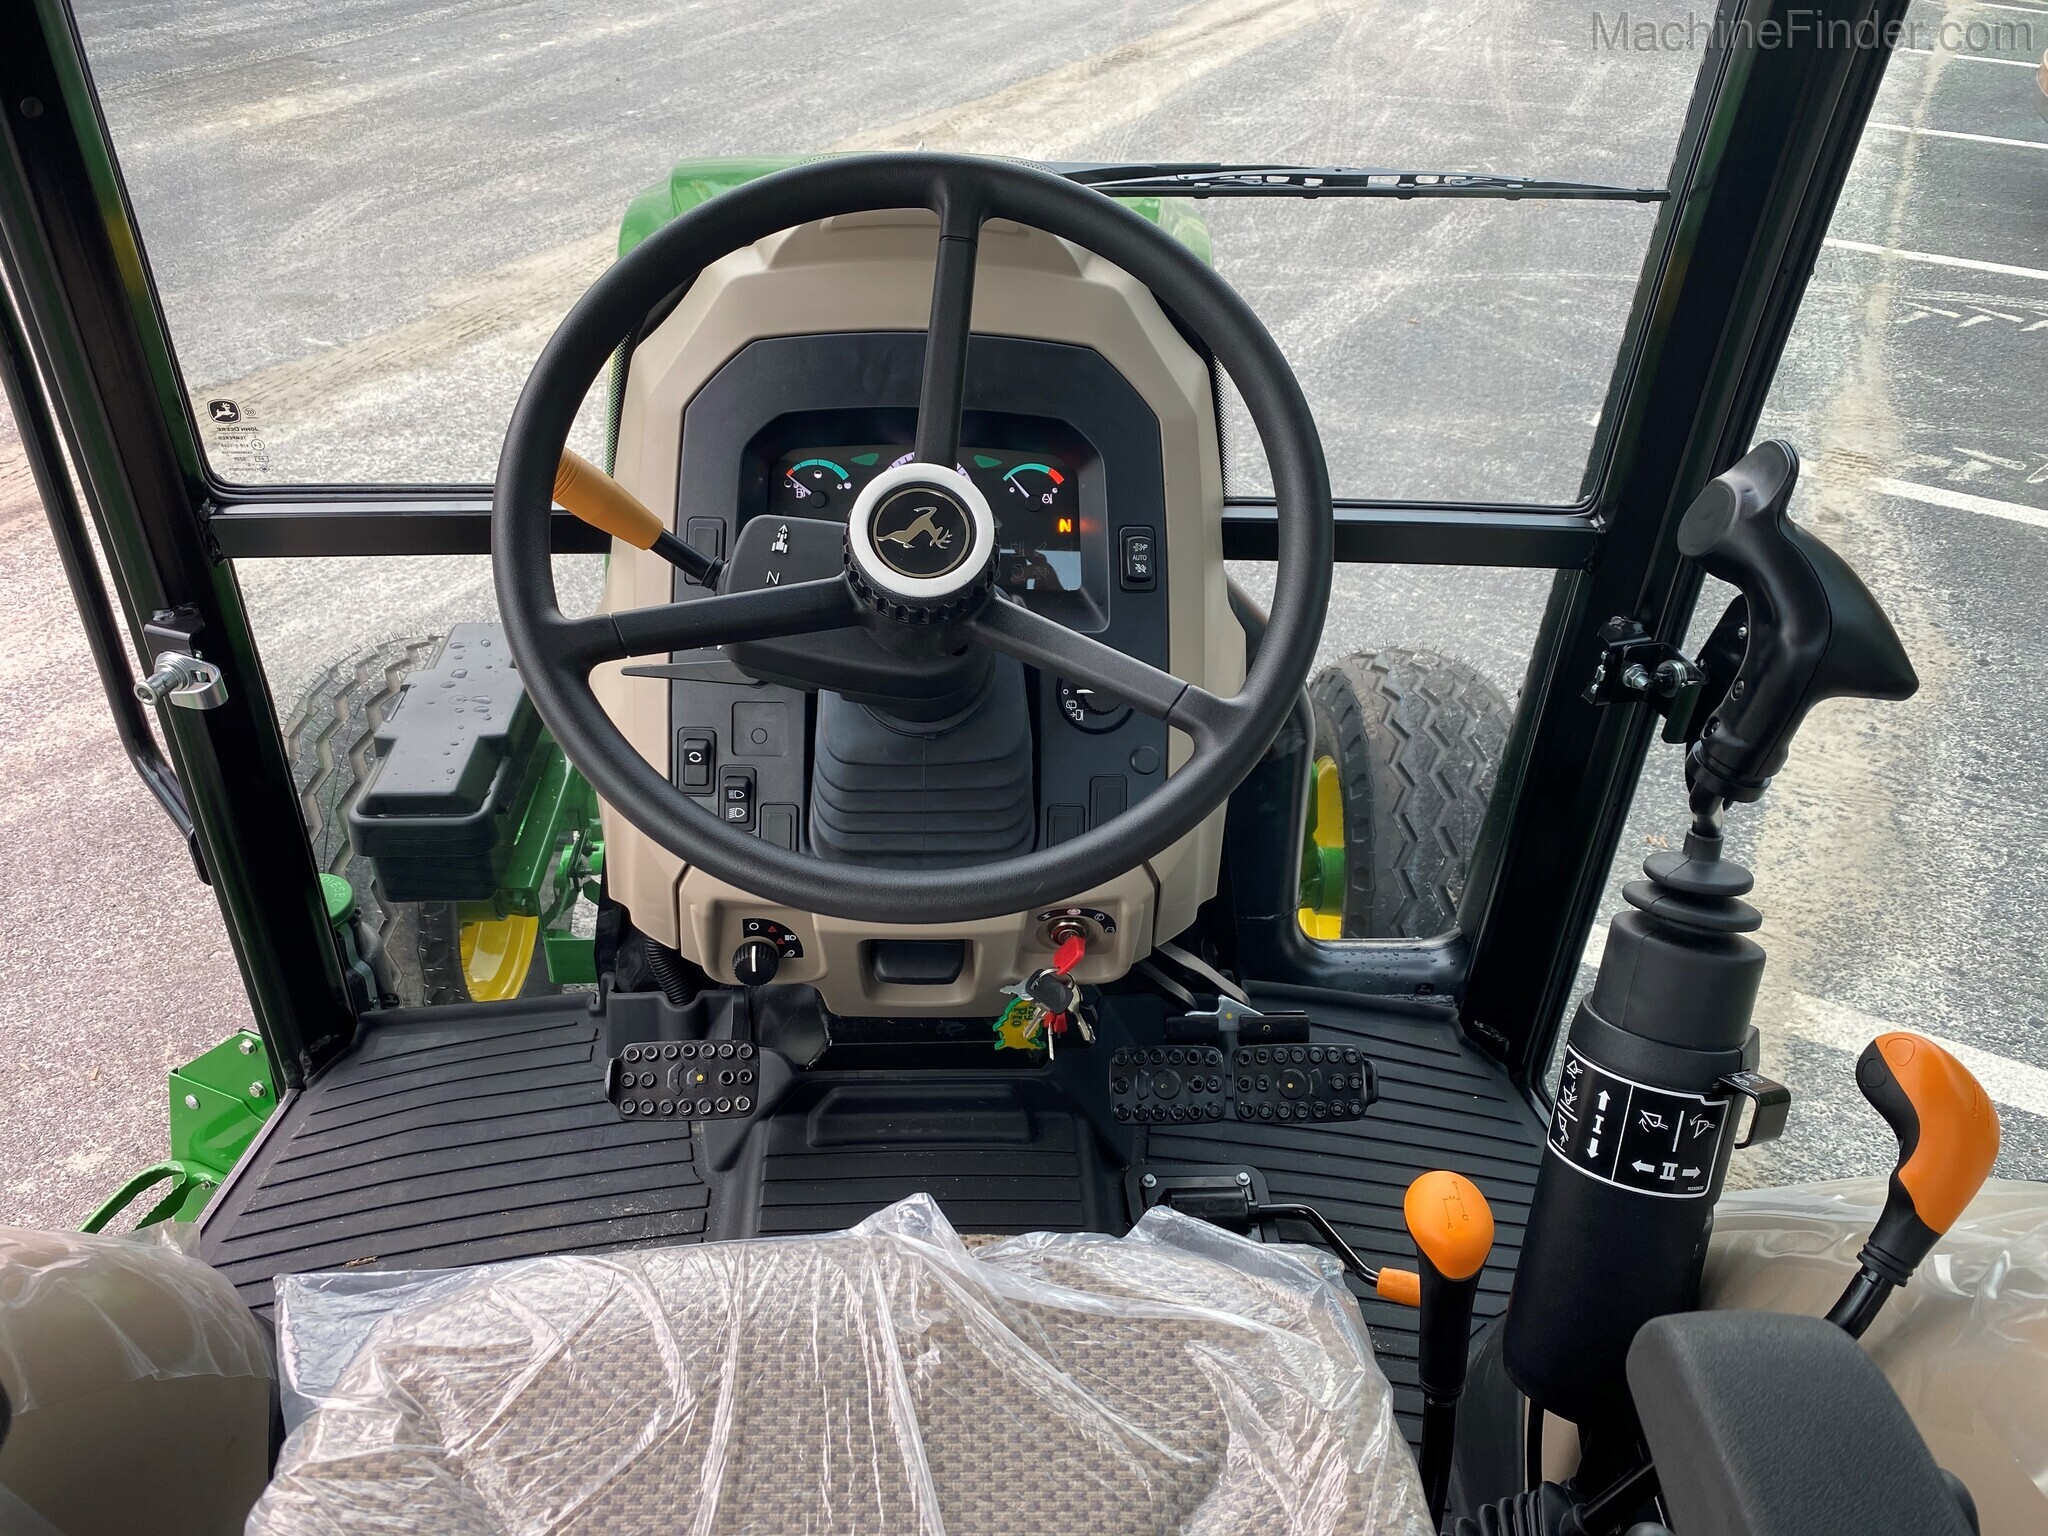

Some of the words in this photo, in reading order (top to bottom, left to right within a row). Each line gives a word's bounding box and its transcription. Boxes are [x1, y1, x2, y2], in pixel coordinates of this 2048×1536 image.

[1059, 518, 1072, 533] N
[765, 570, 780, 585] N
[321, 876, 346, 904] DIESEL
